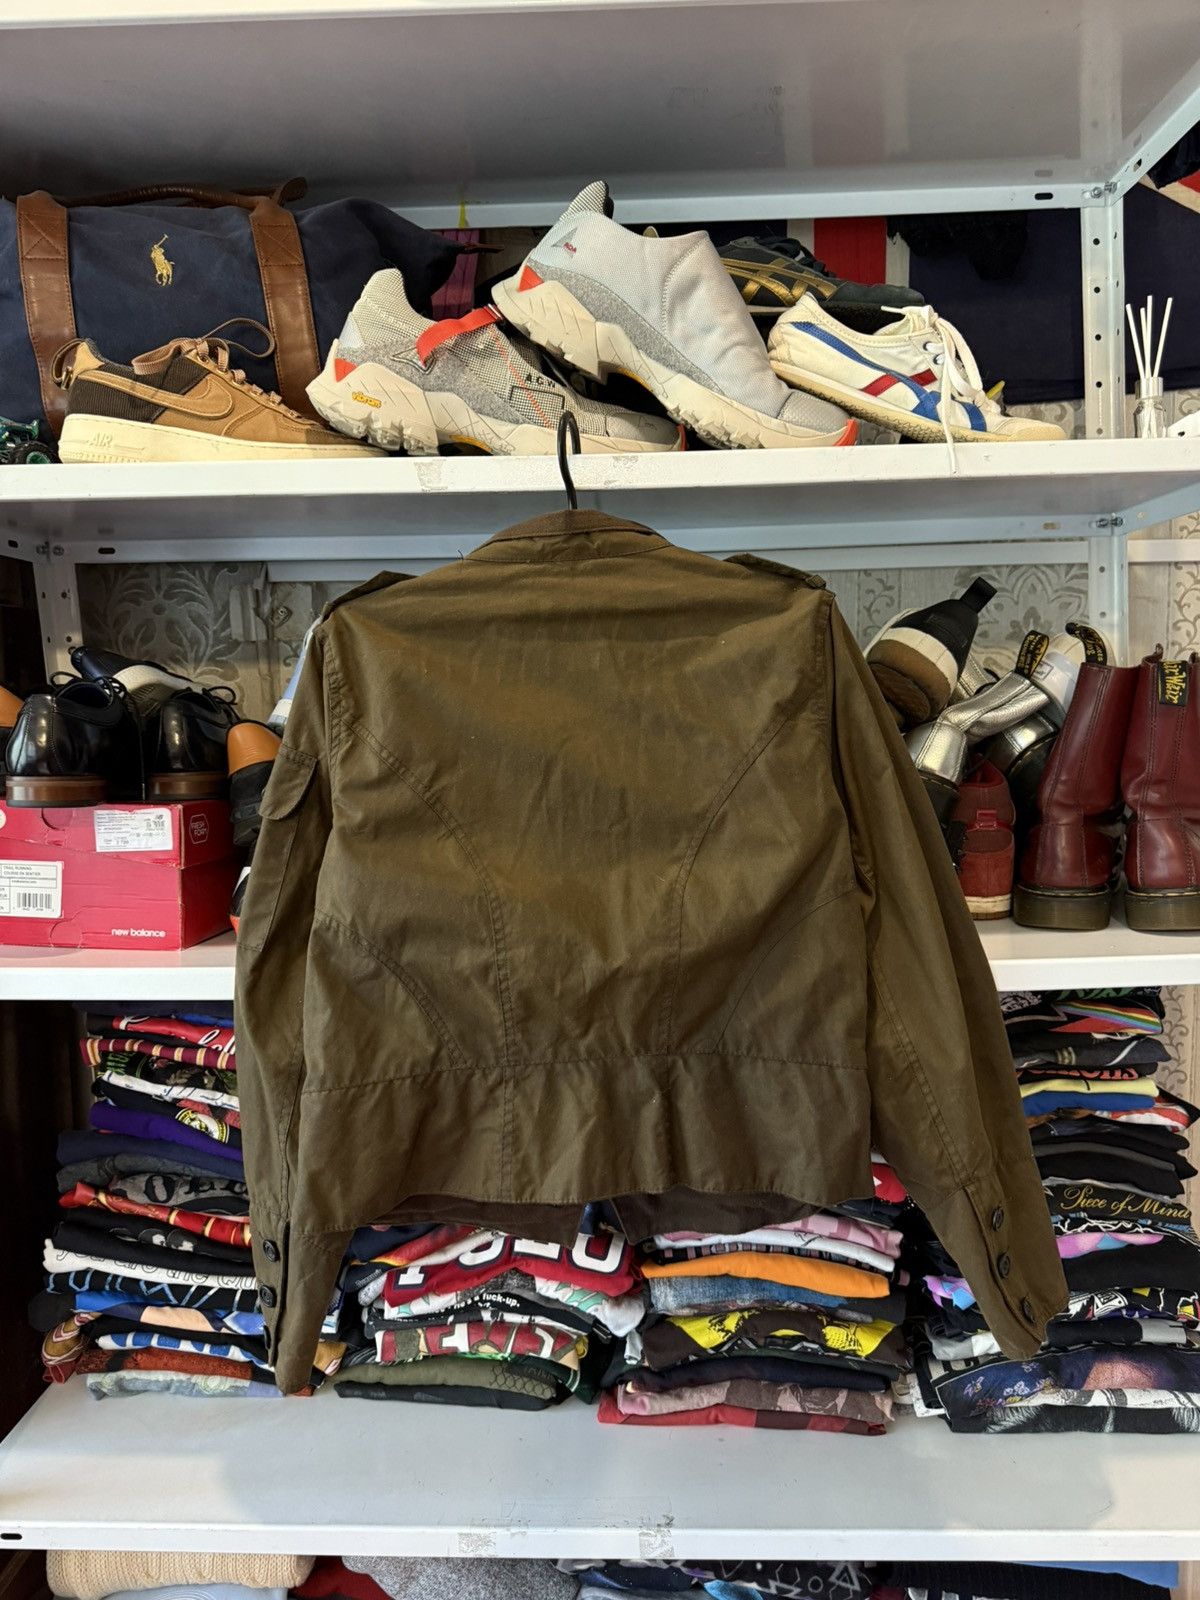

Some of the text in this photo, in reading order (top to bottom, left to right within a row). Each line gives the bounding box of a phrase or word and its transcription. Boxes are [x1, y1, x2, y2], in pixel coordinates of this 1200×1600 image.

[88, 432, 114, 448] AIR
[111, 928, 166, 938] new balance
[1060, 1185, 1107, 1210] Piece
[1110, 1193, 1135, 1217] of
[482, 1292, 520, 1308] fuck-up.
